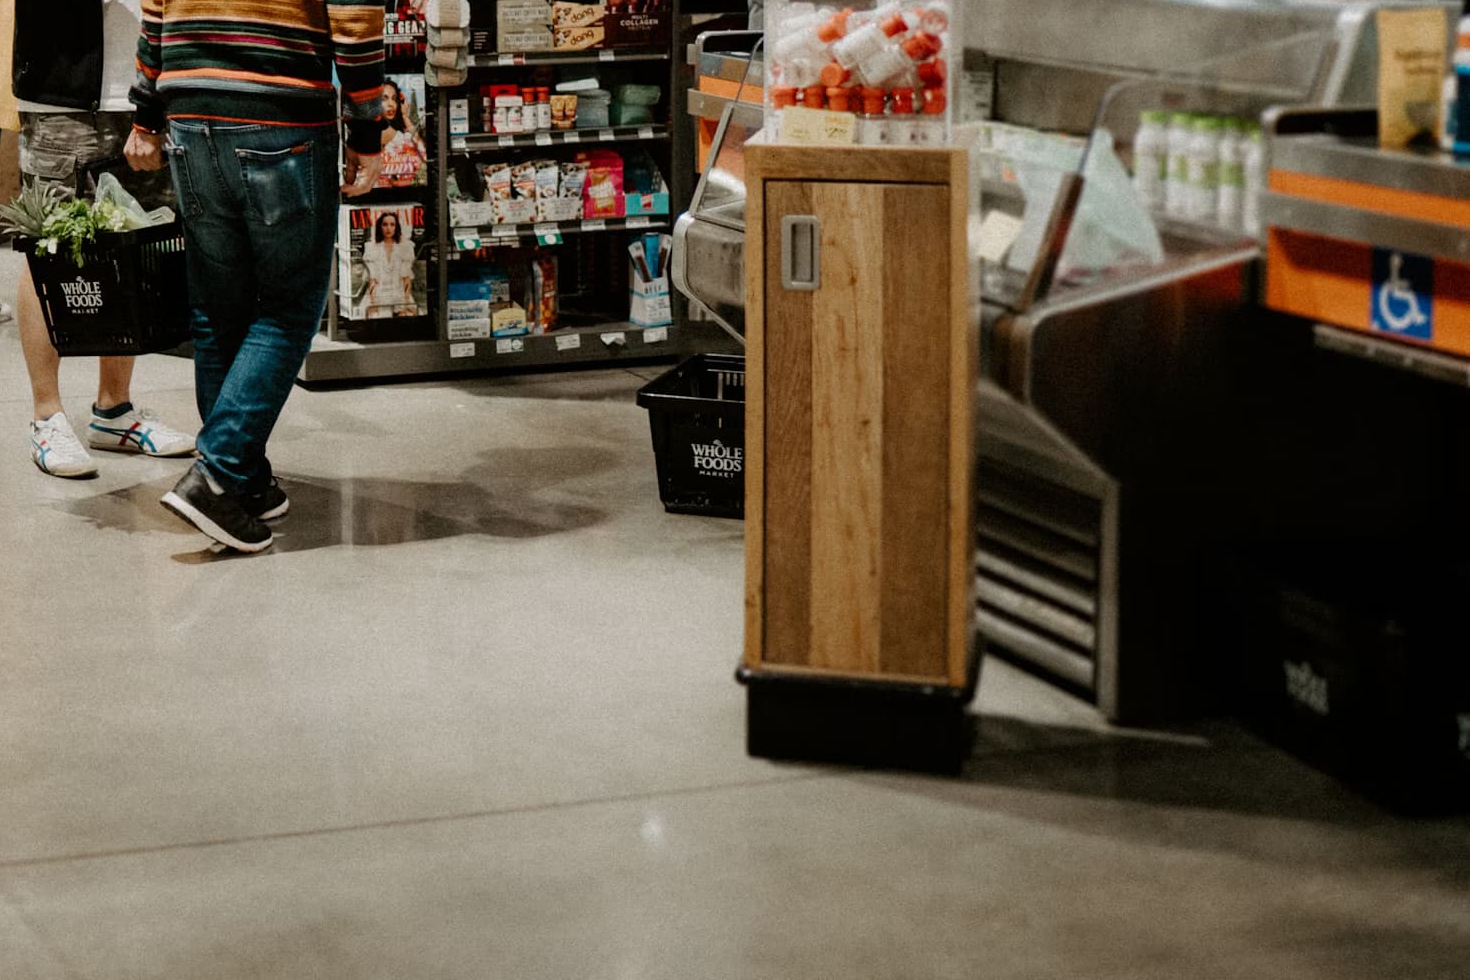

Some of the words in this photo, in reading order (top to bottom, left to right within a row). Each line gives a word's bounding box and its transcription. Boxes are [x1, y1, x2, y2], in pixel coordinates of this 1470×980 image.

[570, 7, 595, 23] dang
[620, 19, 659, 27] COLLAGEN
[570, 29, 595, 45] dang
[60, 281, 102, 295] WHOLE
[65, 294, 104, 308] FOODS
[691, 443, 743, 460] WHOLE
[694, 456, 742, 472] FOODS
[699, 470, 735, 478] MARKET
